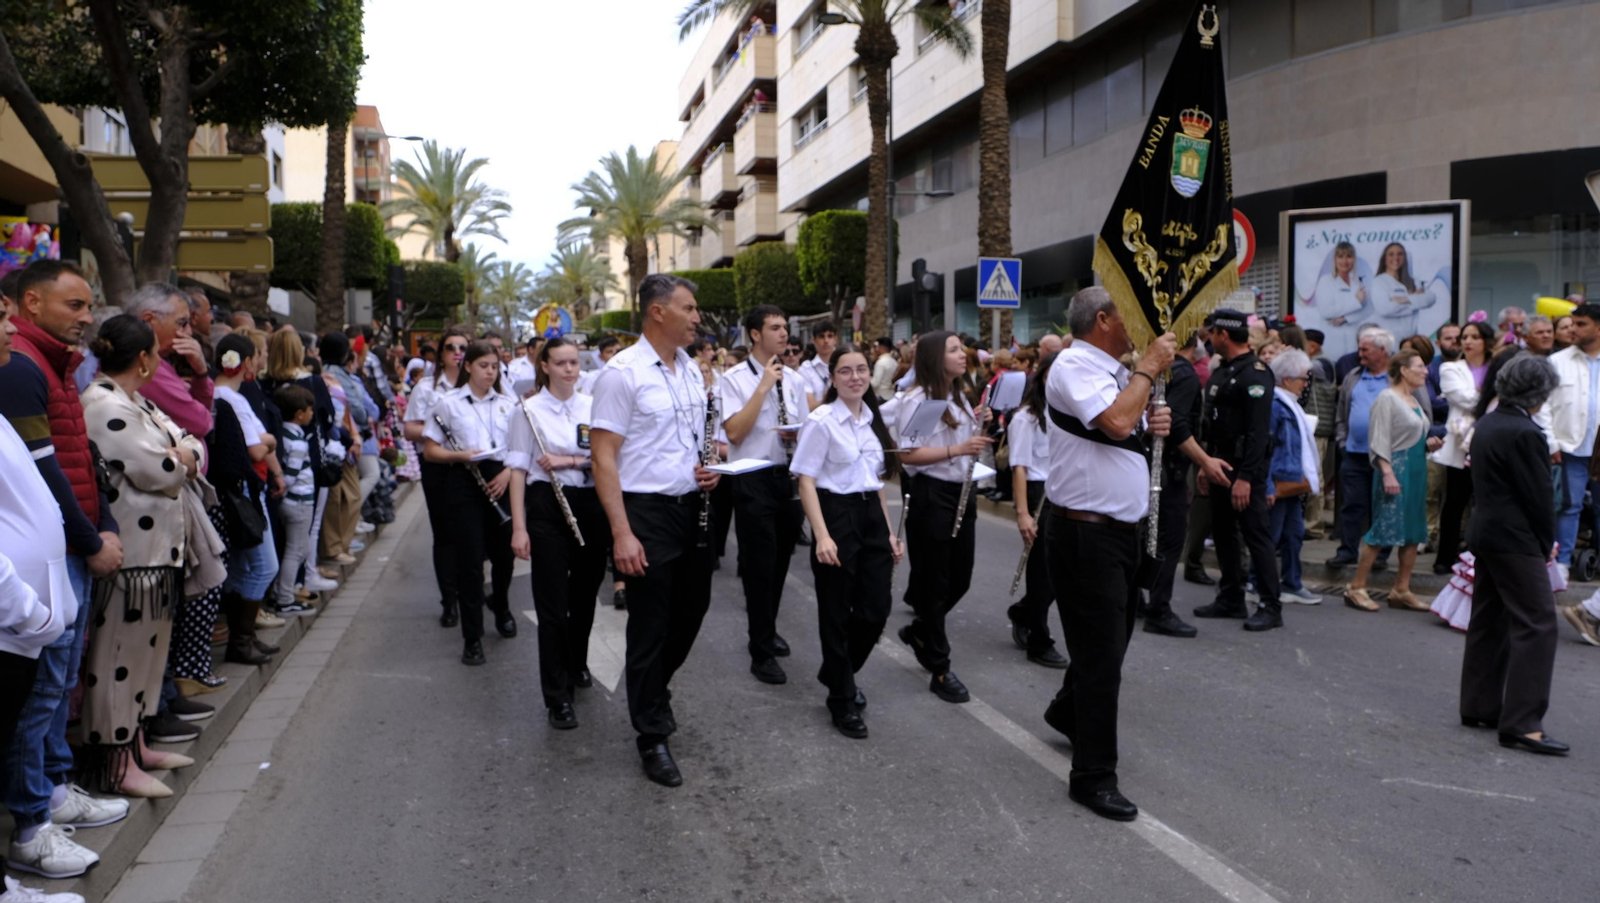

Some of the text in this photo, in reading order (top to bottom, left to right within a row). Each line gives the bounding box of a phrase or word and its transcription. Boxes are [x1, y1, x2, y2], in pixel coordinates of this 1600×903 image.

[1138, 115, 1170, 169] BANDA
[1305, 223, 1444, 249] ¿Nos conoces?
